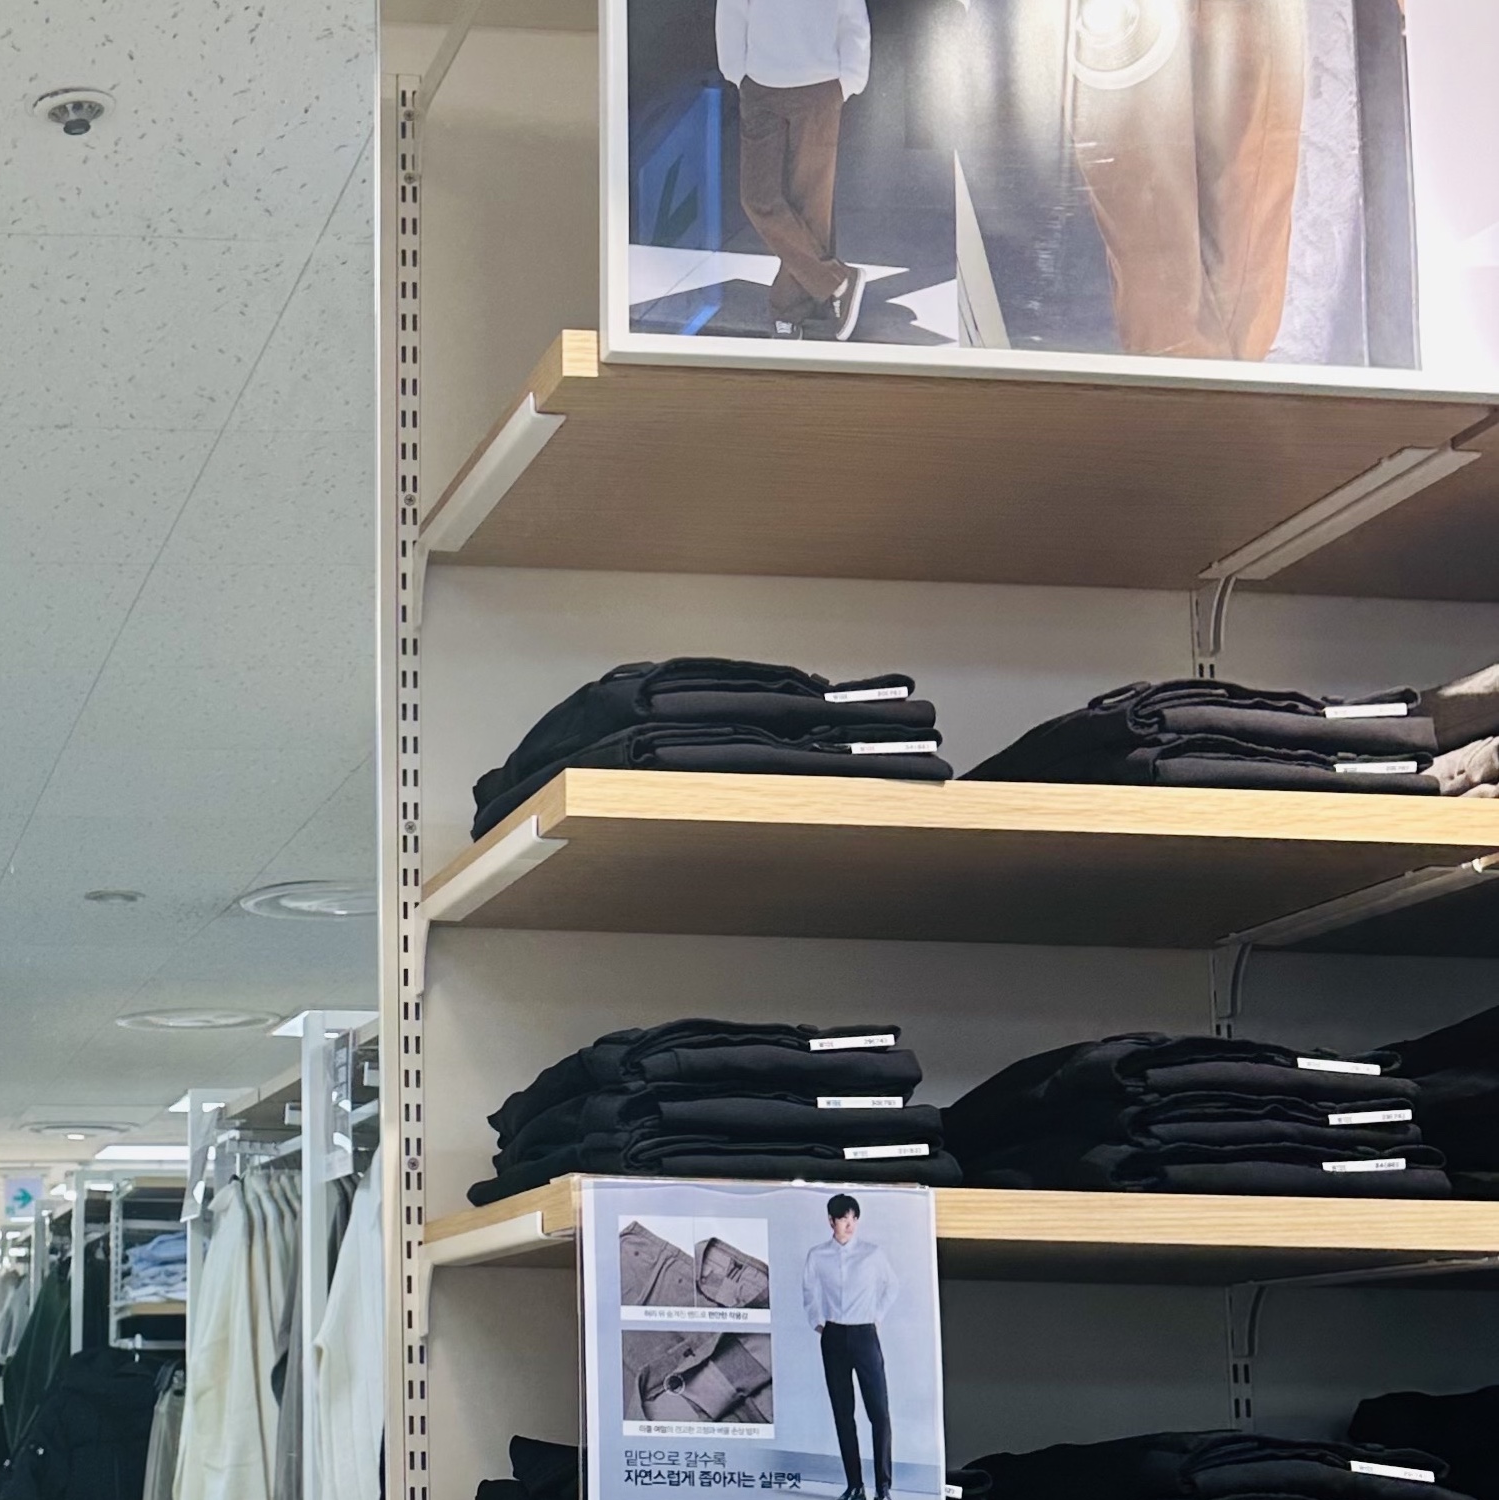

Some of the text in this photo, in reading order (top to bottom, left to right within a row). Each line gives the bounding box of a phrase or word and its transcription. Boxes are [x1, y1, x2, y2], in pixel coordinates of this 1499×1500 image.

[624, 1449, 728, 1468] 밑단으로 갈수록
[623, 1469, 695, 1487] 자연스럽게
[698, 1471, 756, 1489] 좁아지는
